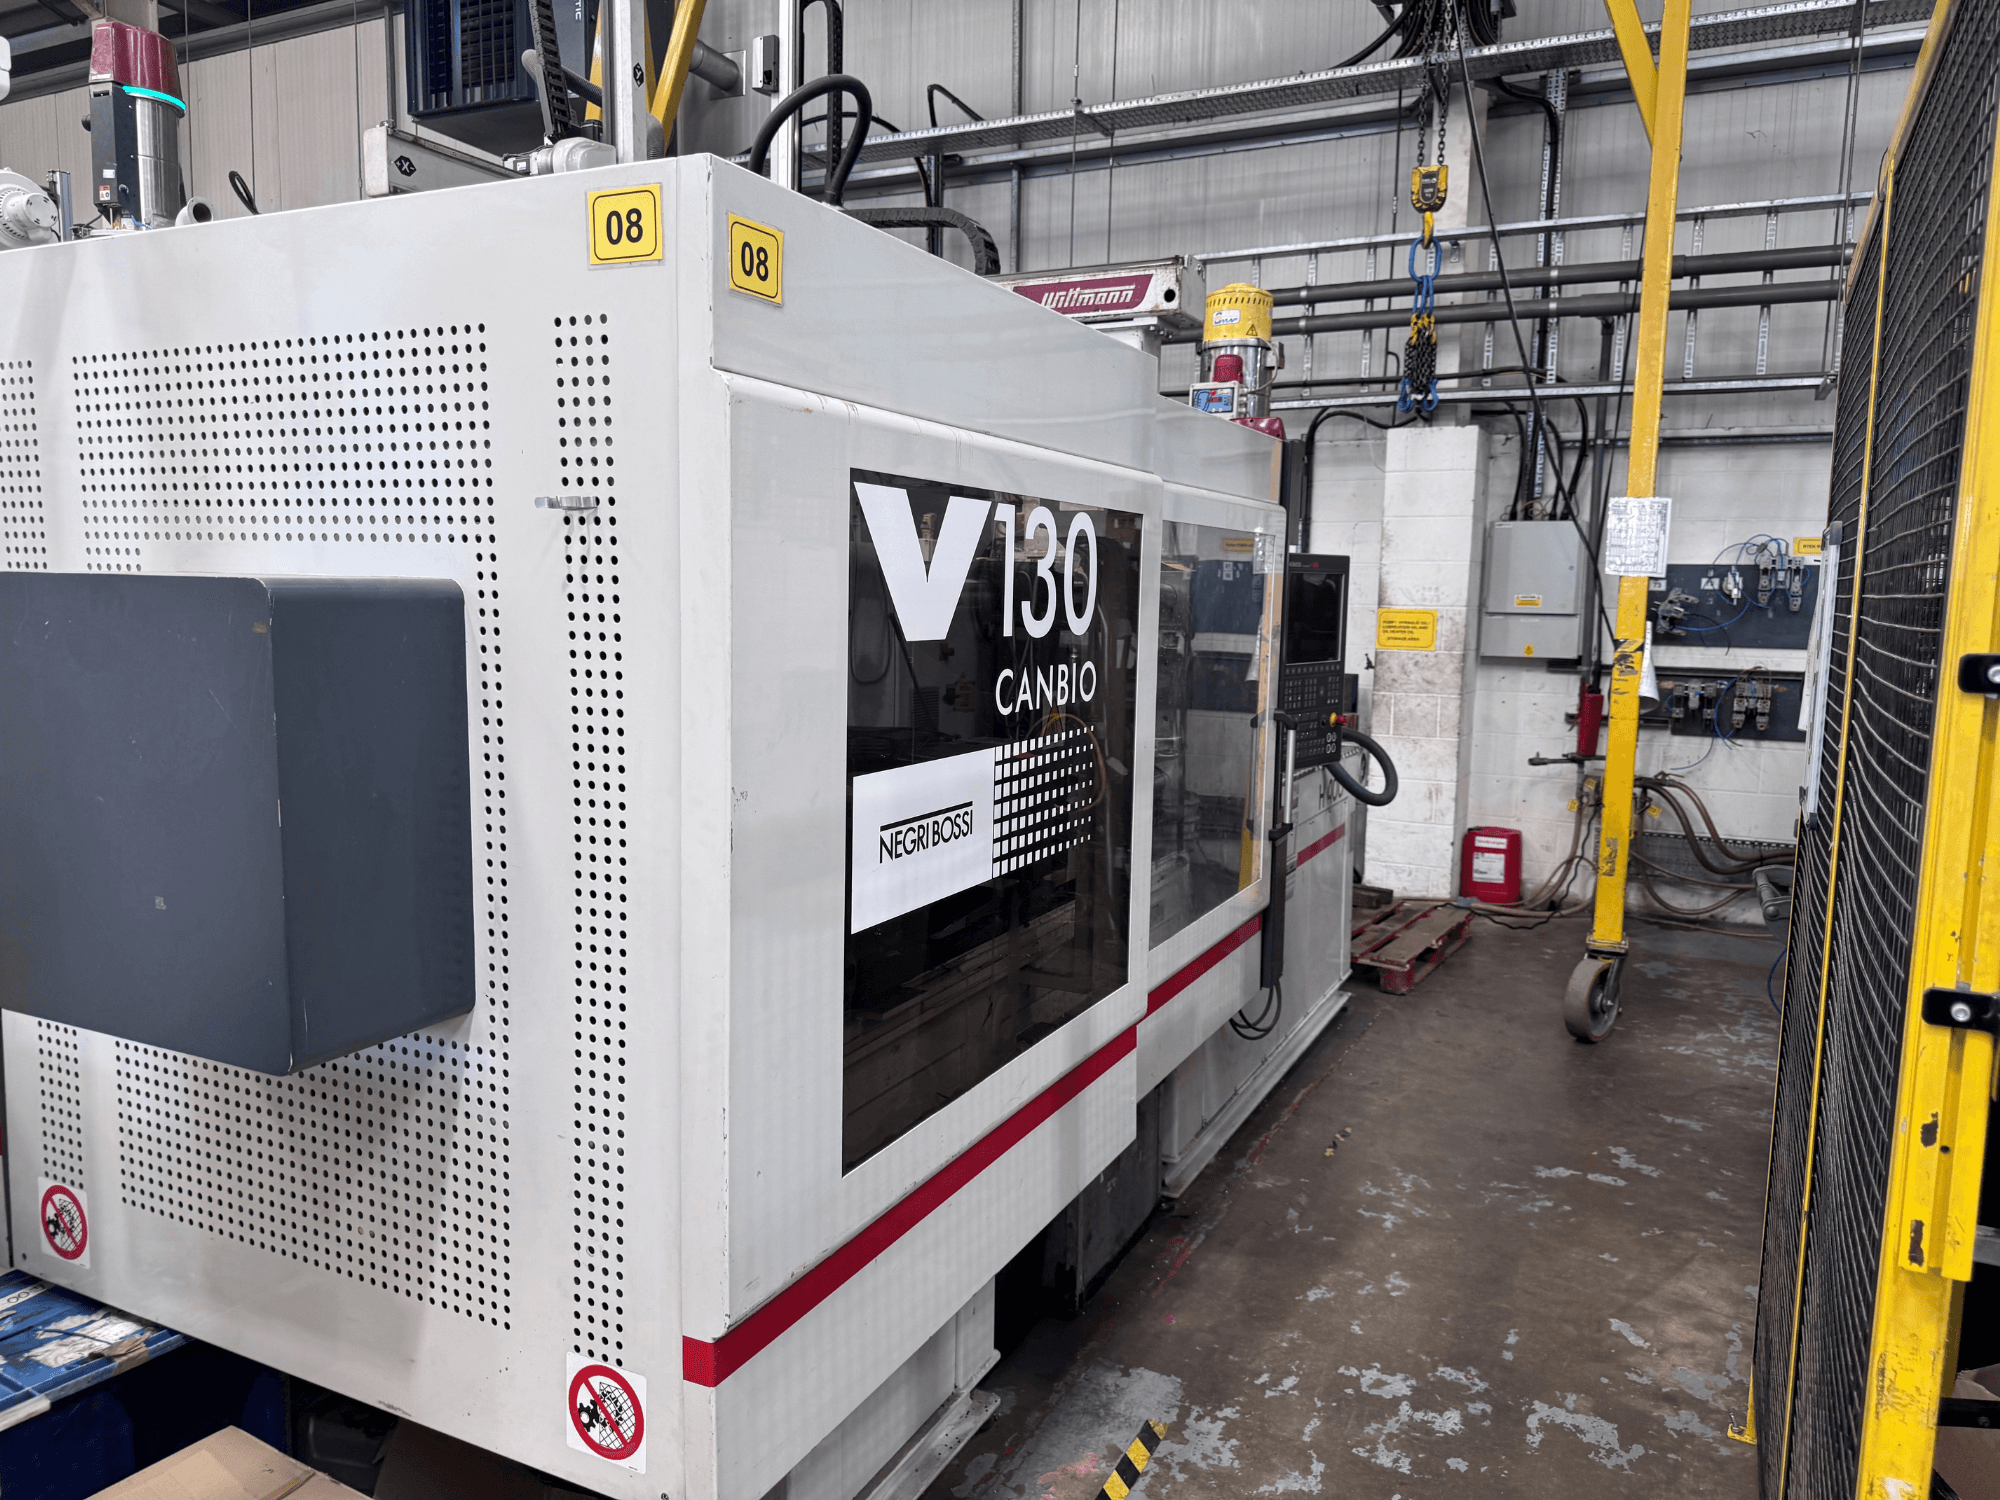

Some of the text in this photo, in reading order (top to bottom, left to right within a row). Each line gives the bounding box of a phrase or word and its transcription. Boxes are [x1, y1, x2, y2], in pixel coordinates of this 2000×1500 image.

[606, 208, 643, 245] 08
[741, 241, 769, 282] 08
[853, 481, 1098, 642] V130
[995, 660, 1097, 716] CANBIO
[879, 809, 973, 864] NEGRI BOSSI
